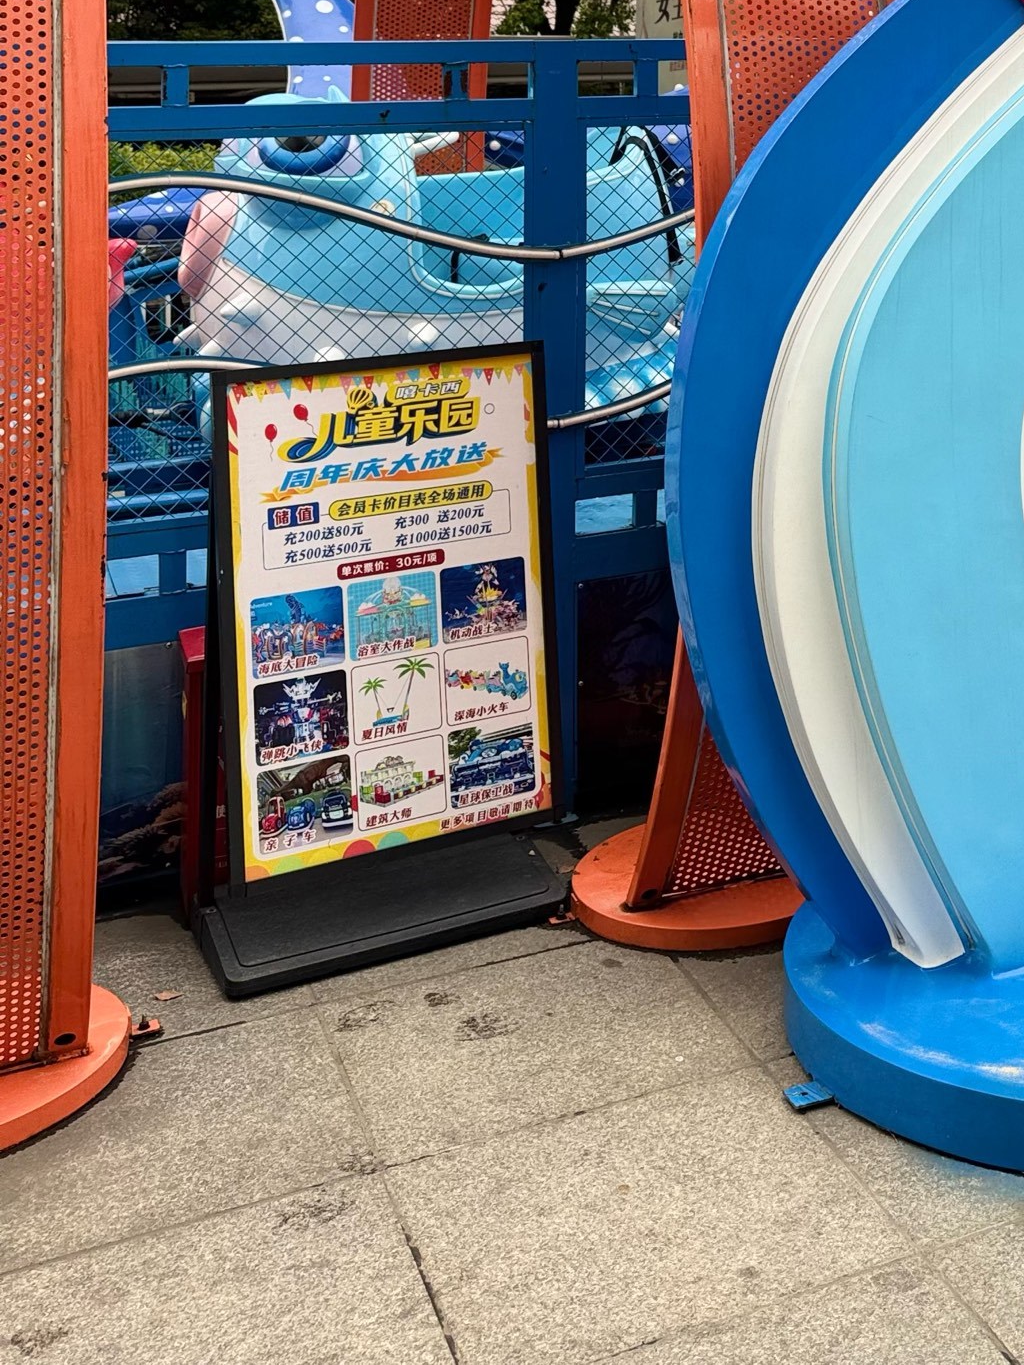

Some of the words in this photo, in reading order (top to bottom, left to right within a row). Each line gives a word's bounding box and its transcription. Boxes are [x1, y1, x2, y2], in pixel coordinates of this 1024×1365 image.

[395, 380, 462, 399] 嘻卡西
[278, 397, 481, 463] 儿童乐园
[280, 441, 488, 492] 周年庆大放送
[337, 483, 486, 517] 会员卡价目表全场通用
[274, 506, 314, 526] 储值
[394, 513, 430, 530] 充300
[436, 504, 486, 524] 送200元
[284, 521, 365, 546] 充200送80元
[395, 520, 493, 548] 充1000送1500元
[284, 538, 373, 564] 充500送500元
[450, 625, 495, 641] 机动战士
[357, 637, 415, 657] 浴室大作战
[258, 654, 318, 675] 海底大冒险
[454, 701, 510, 722] 深海小火车
[362, 722, 409, 741] 夏日风情
[261, 739, 323, 762] 弹跳小飞侠
[459, 783, 514, 805] 星球保卫战
[366, 807, 413, 827] 建筑大师
[265, 829, 316, 851] 亲子车
